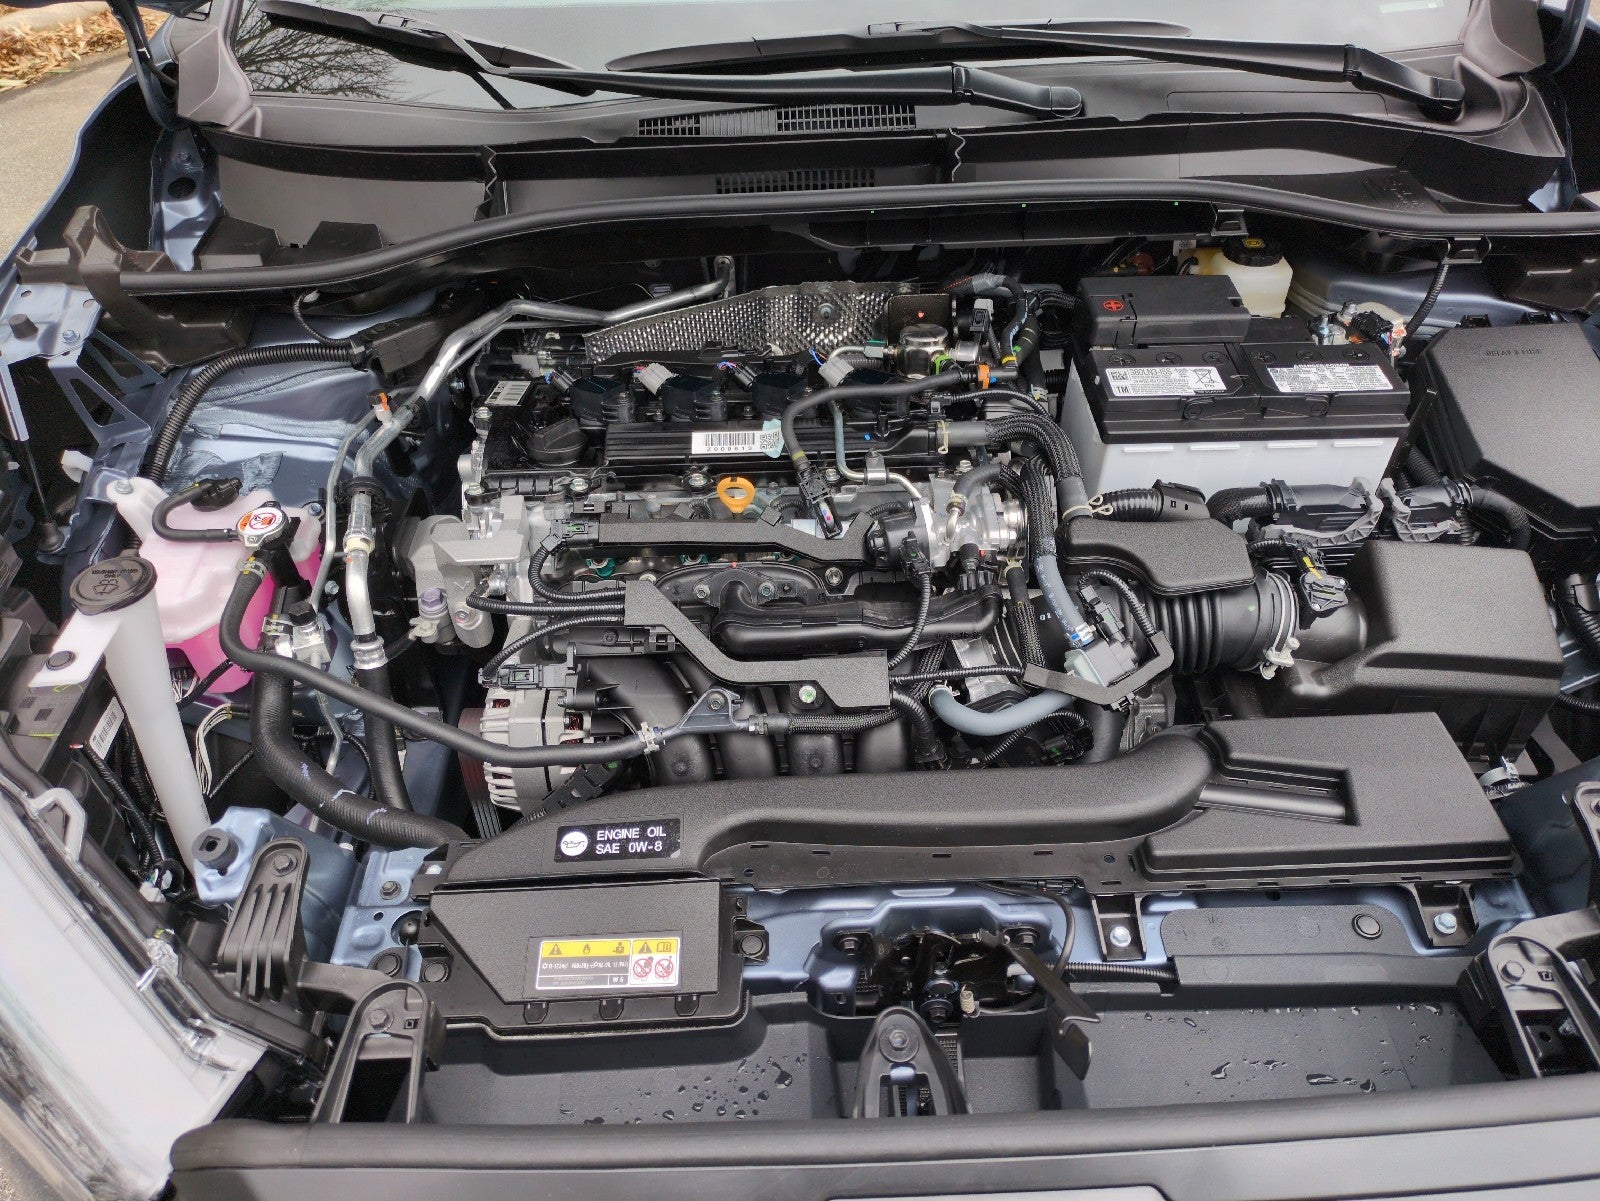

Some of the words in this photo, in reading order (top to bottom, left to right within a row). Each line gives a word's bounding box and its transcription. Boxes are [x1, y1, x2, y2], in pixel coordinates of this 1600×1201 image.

[596, 827, 640, 841] ENGINE
[646, 826, 667, 838] OIL
[595, 842, 620, 855] SAE
[628, 840, 663, 853] 0W-8
